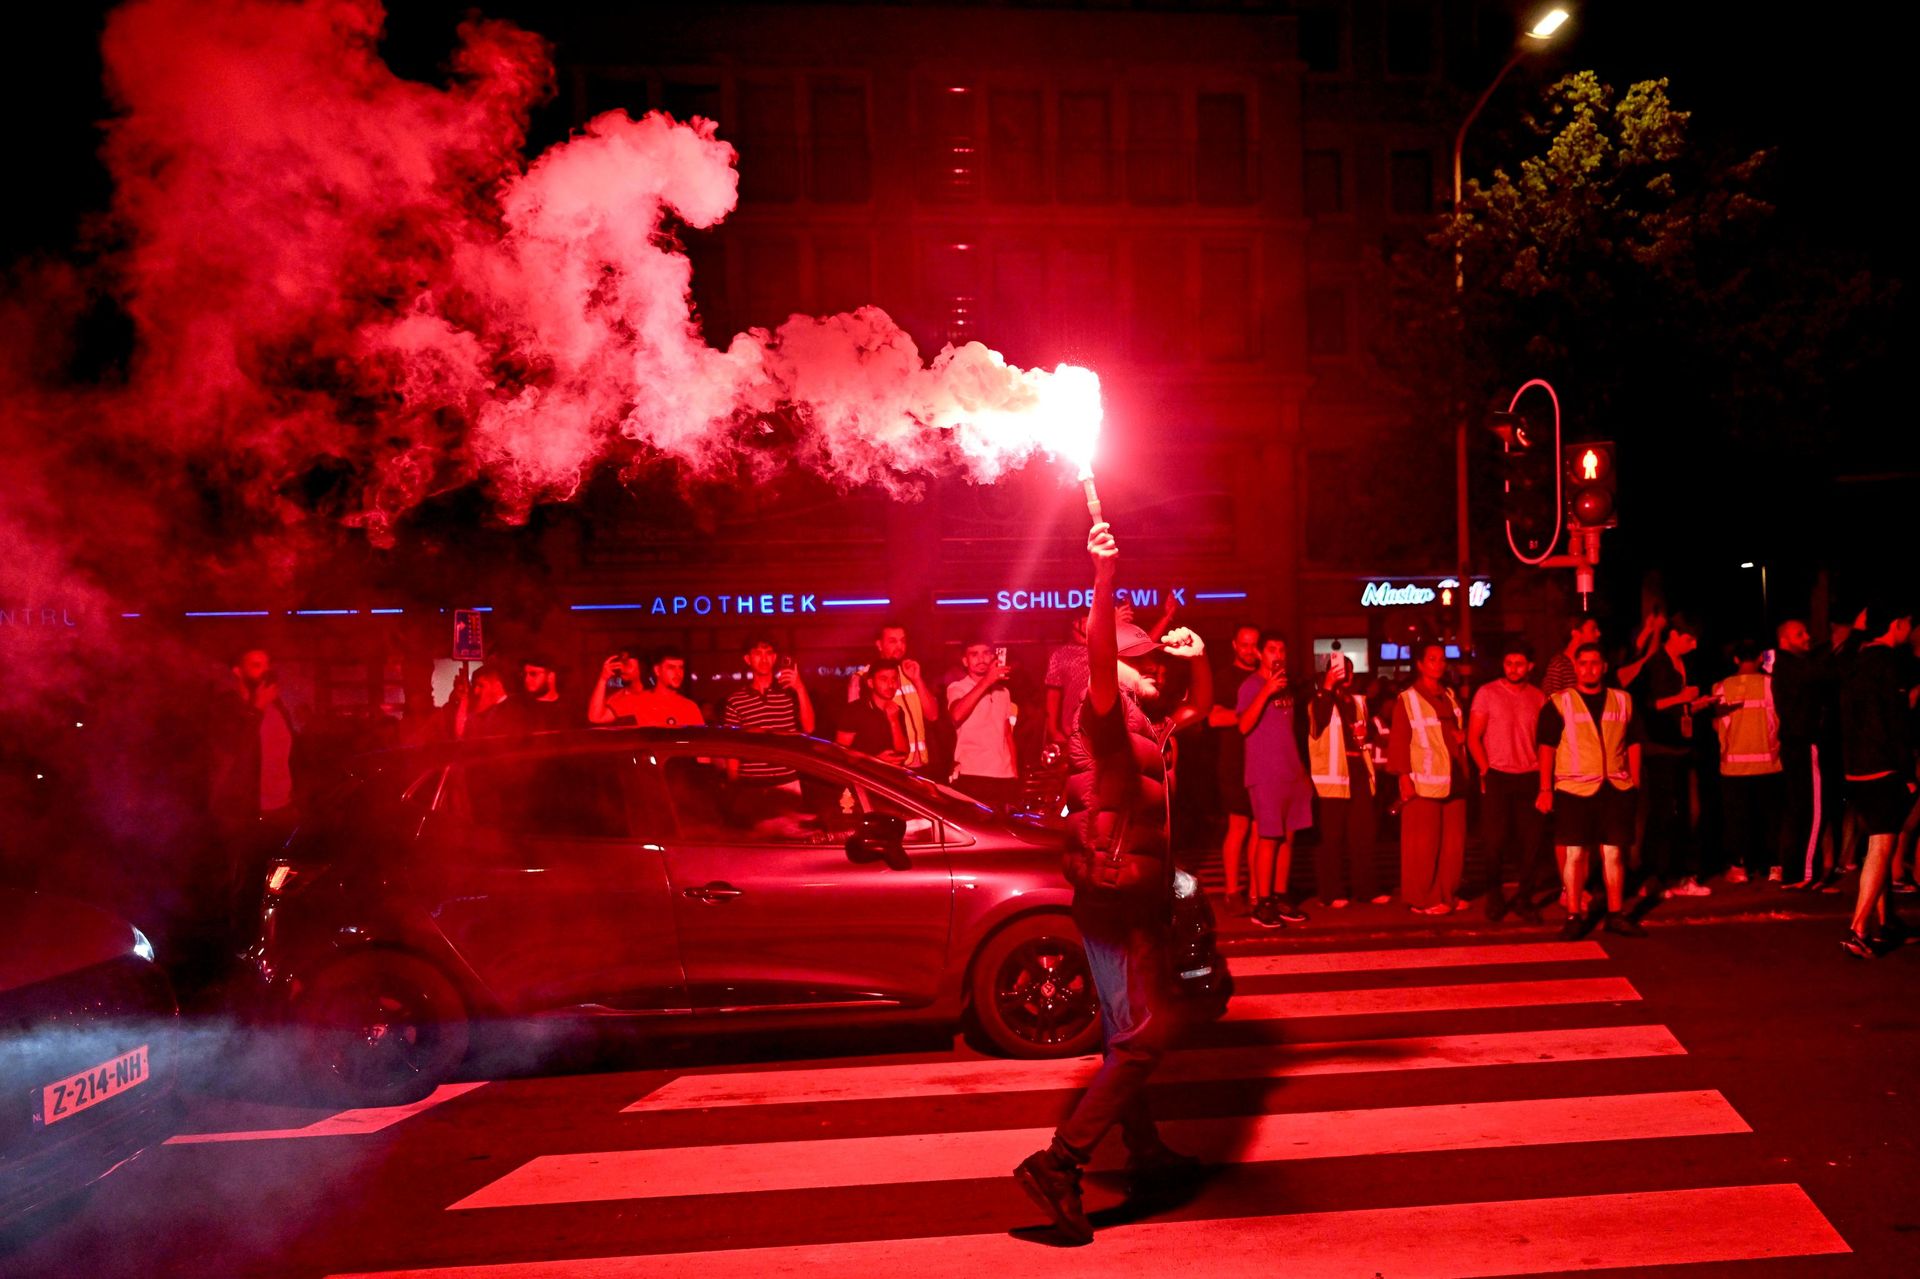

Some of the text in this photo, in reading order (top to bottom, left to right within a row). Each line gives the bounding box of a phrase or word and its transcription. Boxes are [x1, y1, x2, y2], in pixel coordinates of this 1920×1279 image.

[651, 593, 817, 615] APOTHEEK
[997, 588, 1186, 611] SCHILDESWIK
[1361, 581, 1436, 607] Master
[53, 1053, 141, 1116] Z-214-NH
